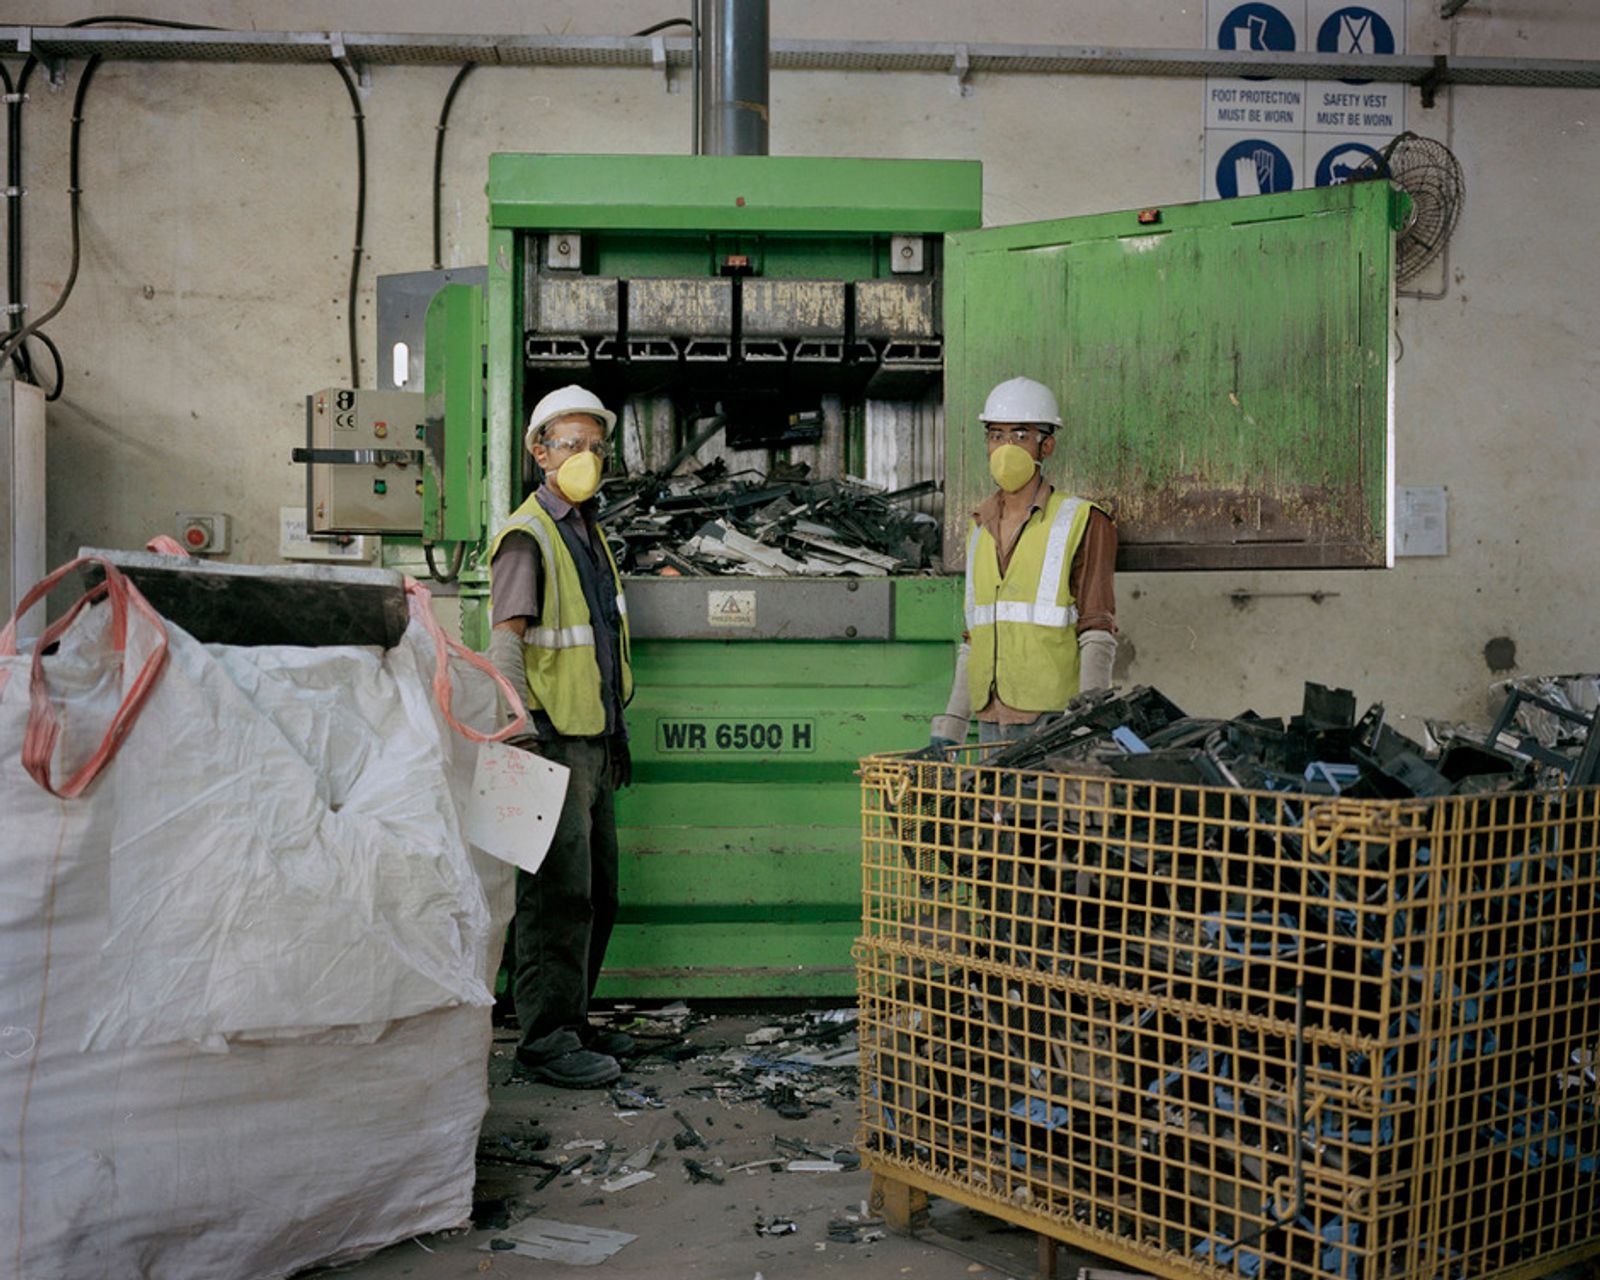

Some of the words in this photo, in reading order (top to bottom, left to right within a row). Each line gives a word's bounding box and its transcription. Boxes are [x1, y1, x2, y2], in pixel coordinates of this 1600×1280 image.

[1212, 89, 1237, 103] FOOT
[1240, 90, 1300, 105] PROTECTION
[1323, 93, 1360, 107] SAFETY
[1363, 95, 1387, 108] VEST
[1218, 108, 1246, 122] MUST
[1248, 109, 1261, 122] BE
[1264, 110, 1294, 123] WORN
[1317, 112, 1345, 125] MUST
[1347, 113, 1360, 126] BE
[1363, 114, 1393, 127] WORN
[336, 413, 354, 428] CE
[662, 723, 707, 749] WR
[715, 723, 783, 749] 6500
[792, 723, 812, 749] H
